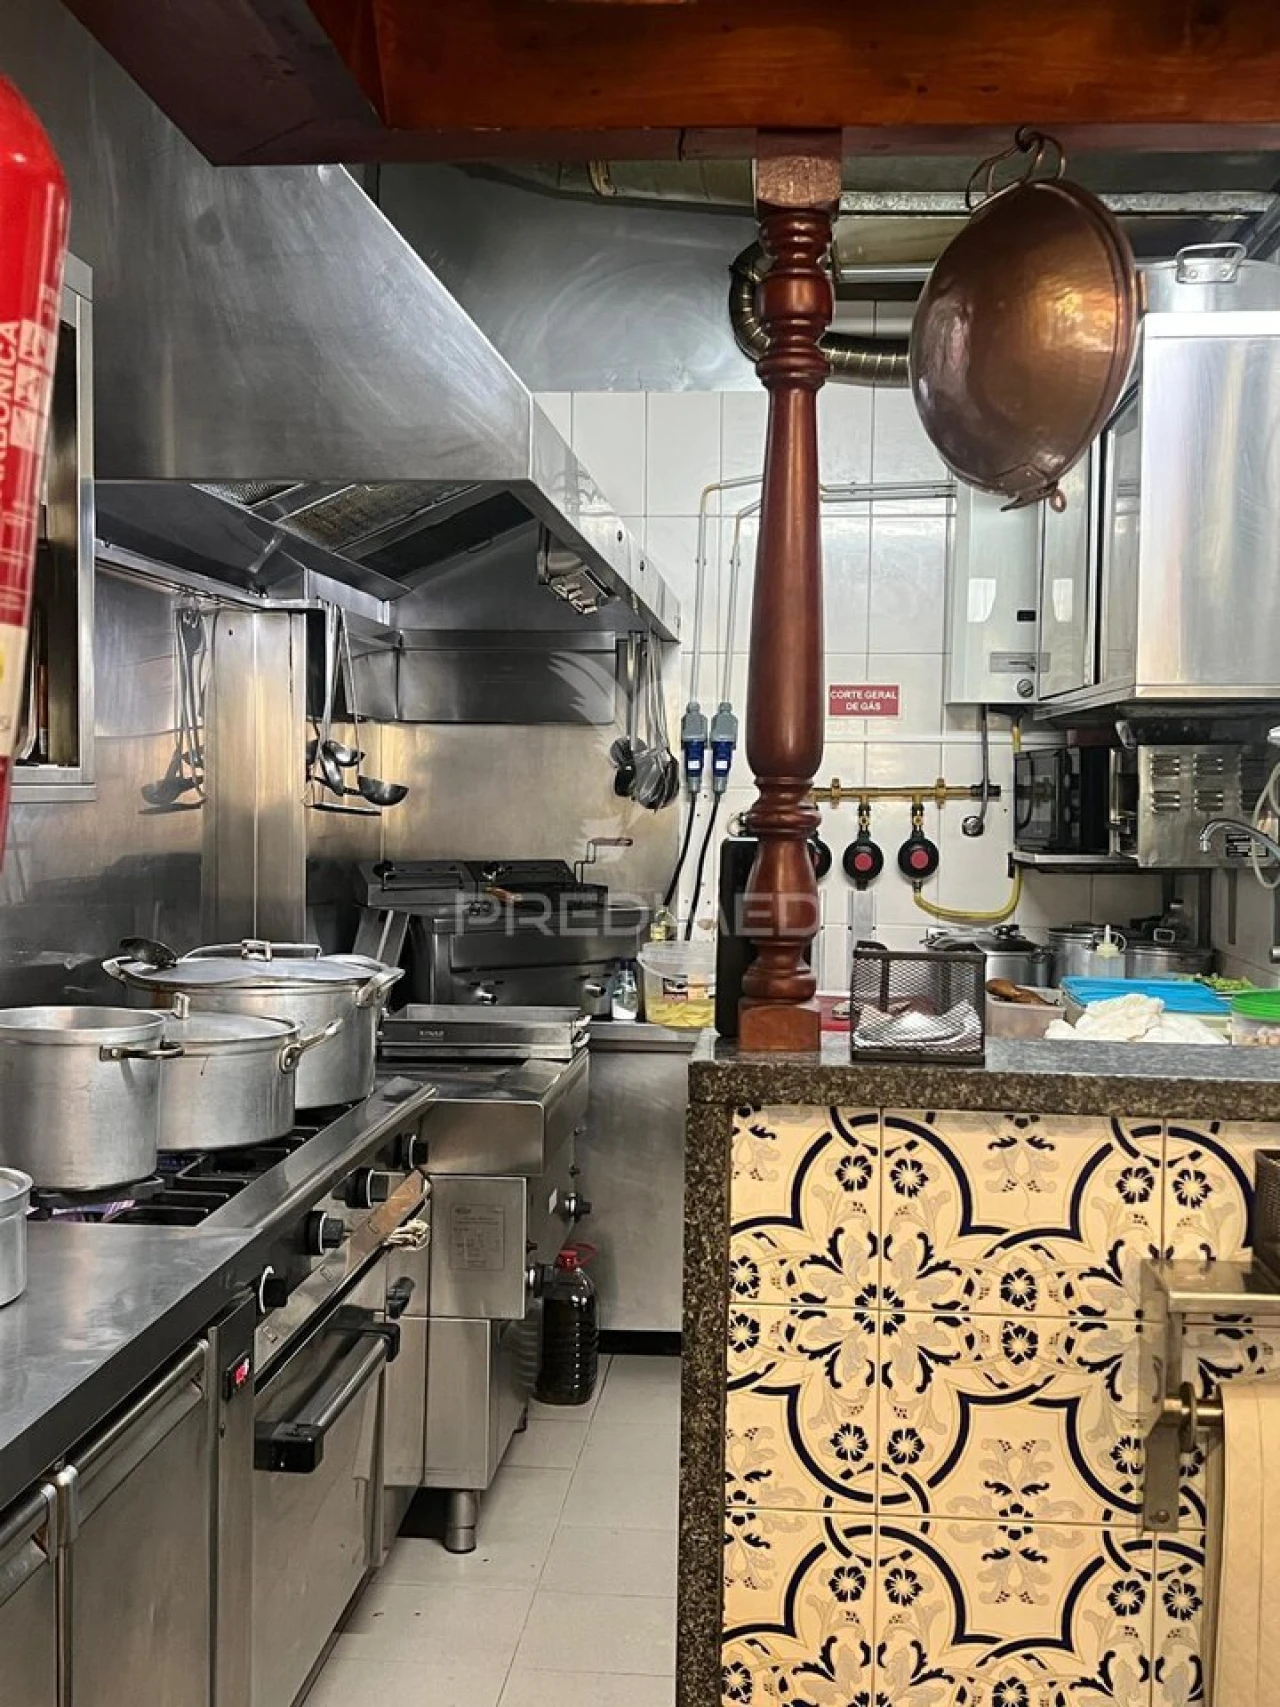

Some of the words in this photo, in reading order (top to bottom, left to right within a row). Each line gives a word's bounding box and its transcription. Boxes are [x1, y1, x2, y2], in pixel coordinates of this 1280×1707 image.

[830, 690, 862, 699] CORTE
[864, 690, 896, 699] GERAL
[845, 702, 858, 710] DE
